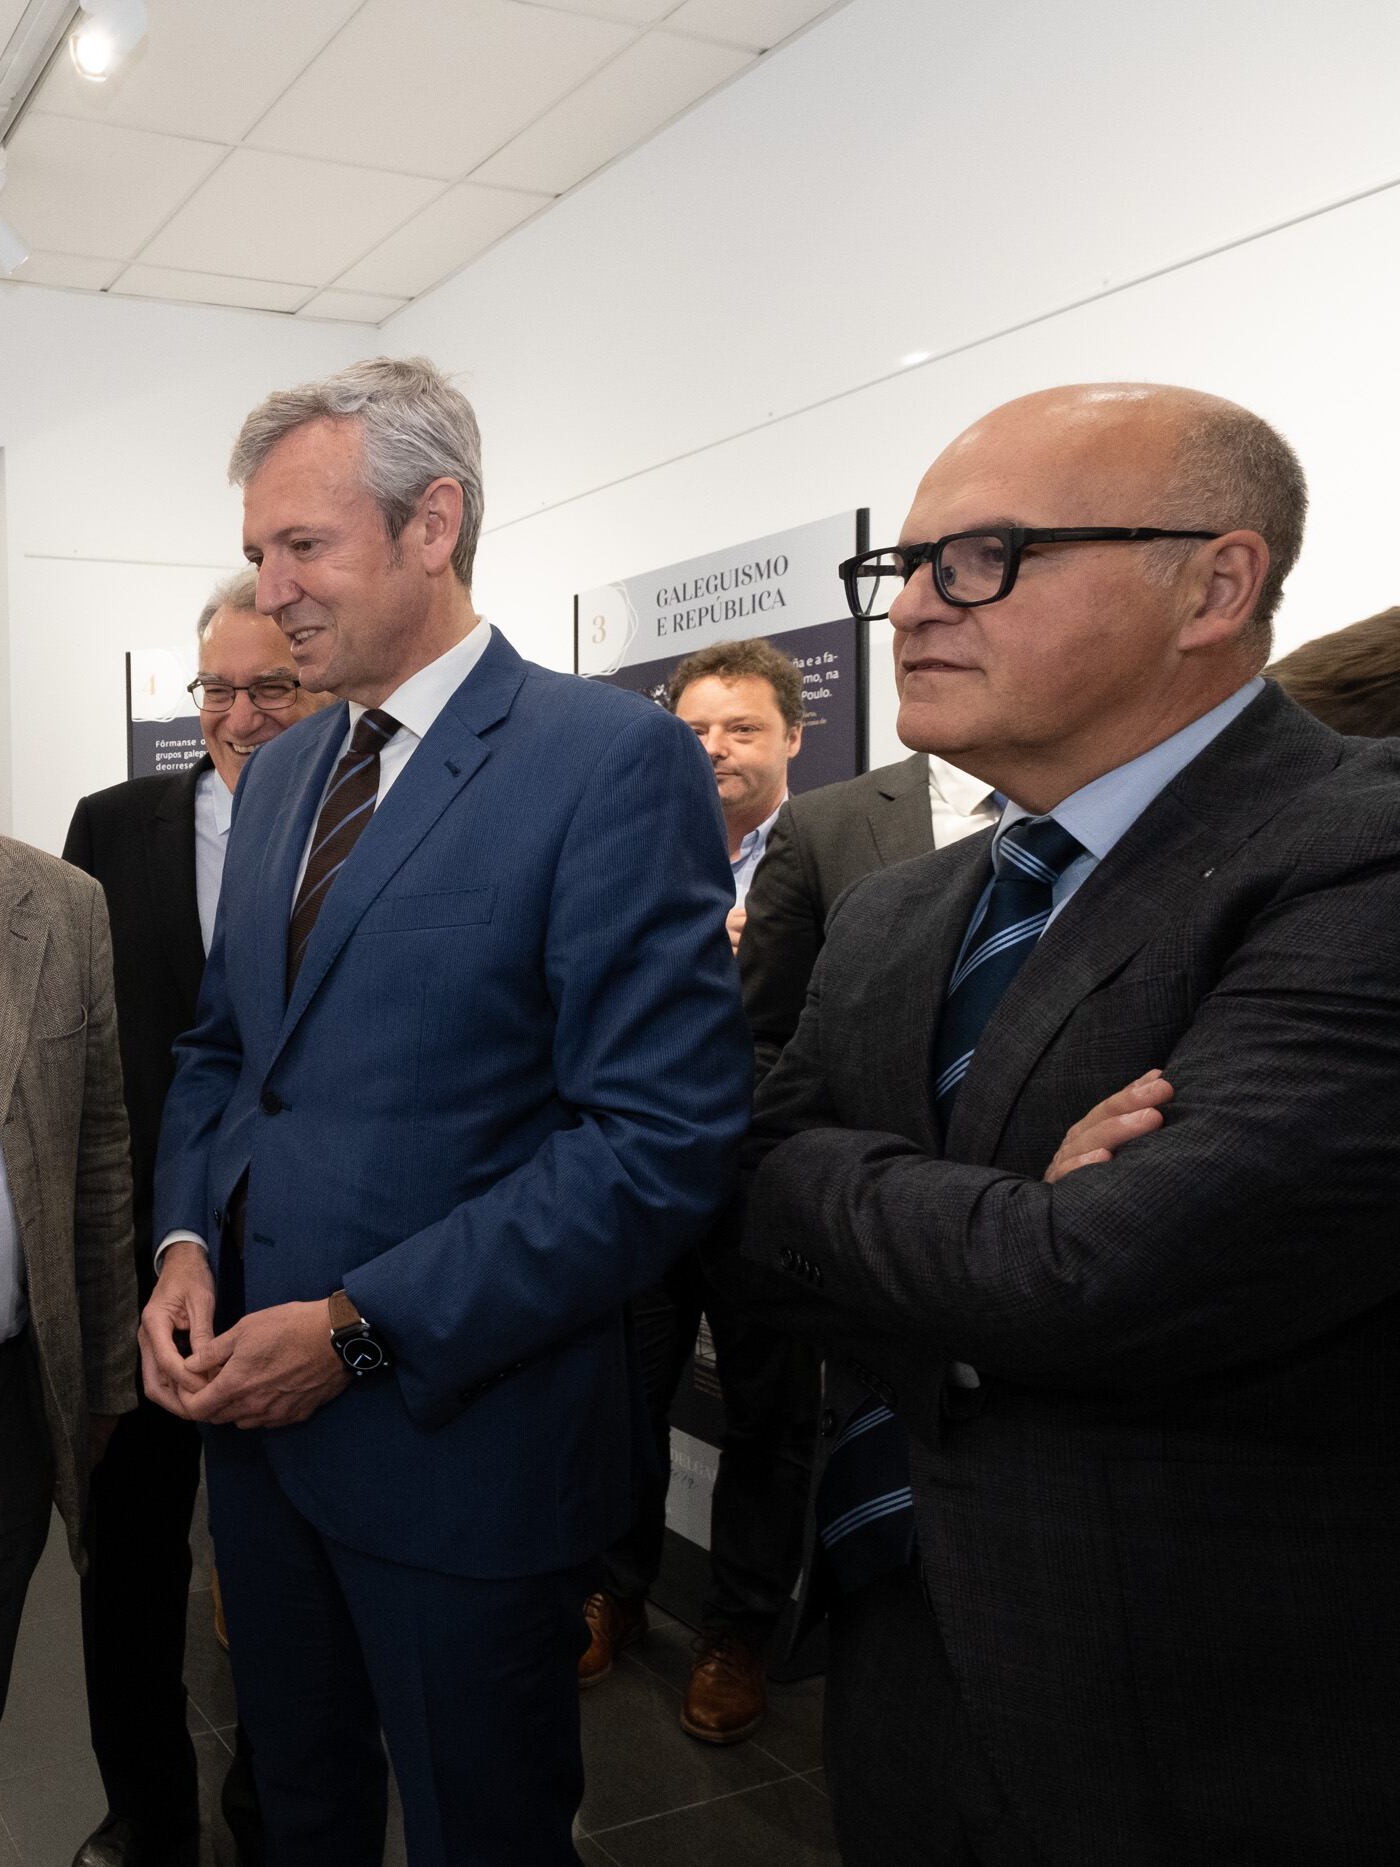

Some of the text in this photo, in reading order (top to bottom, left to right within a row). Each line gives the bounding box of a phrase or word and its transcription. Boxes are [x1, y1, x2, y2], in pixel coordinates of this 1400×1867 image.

[656, 554, 789, 609] GALEGUISMO
[657, 587, 787, 637] E REPÚBLICA
[591, 615, 608, 644] 3
[806, 651, 838, 666] e a fa-
[825, 670, 839, 680] na
[155, 739, 197, 748] Fórmanse
[155, 752, 182, 761] grupos
